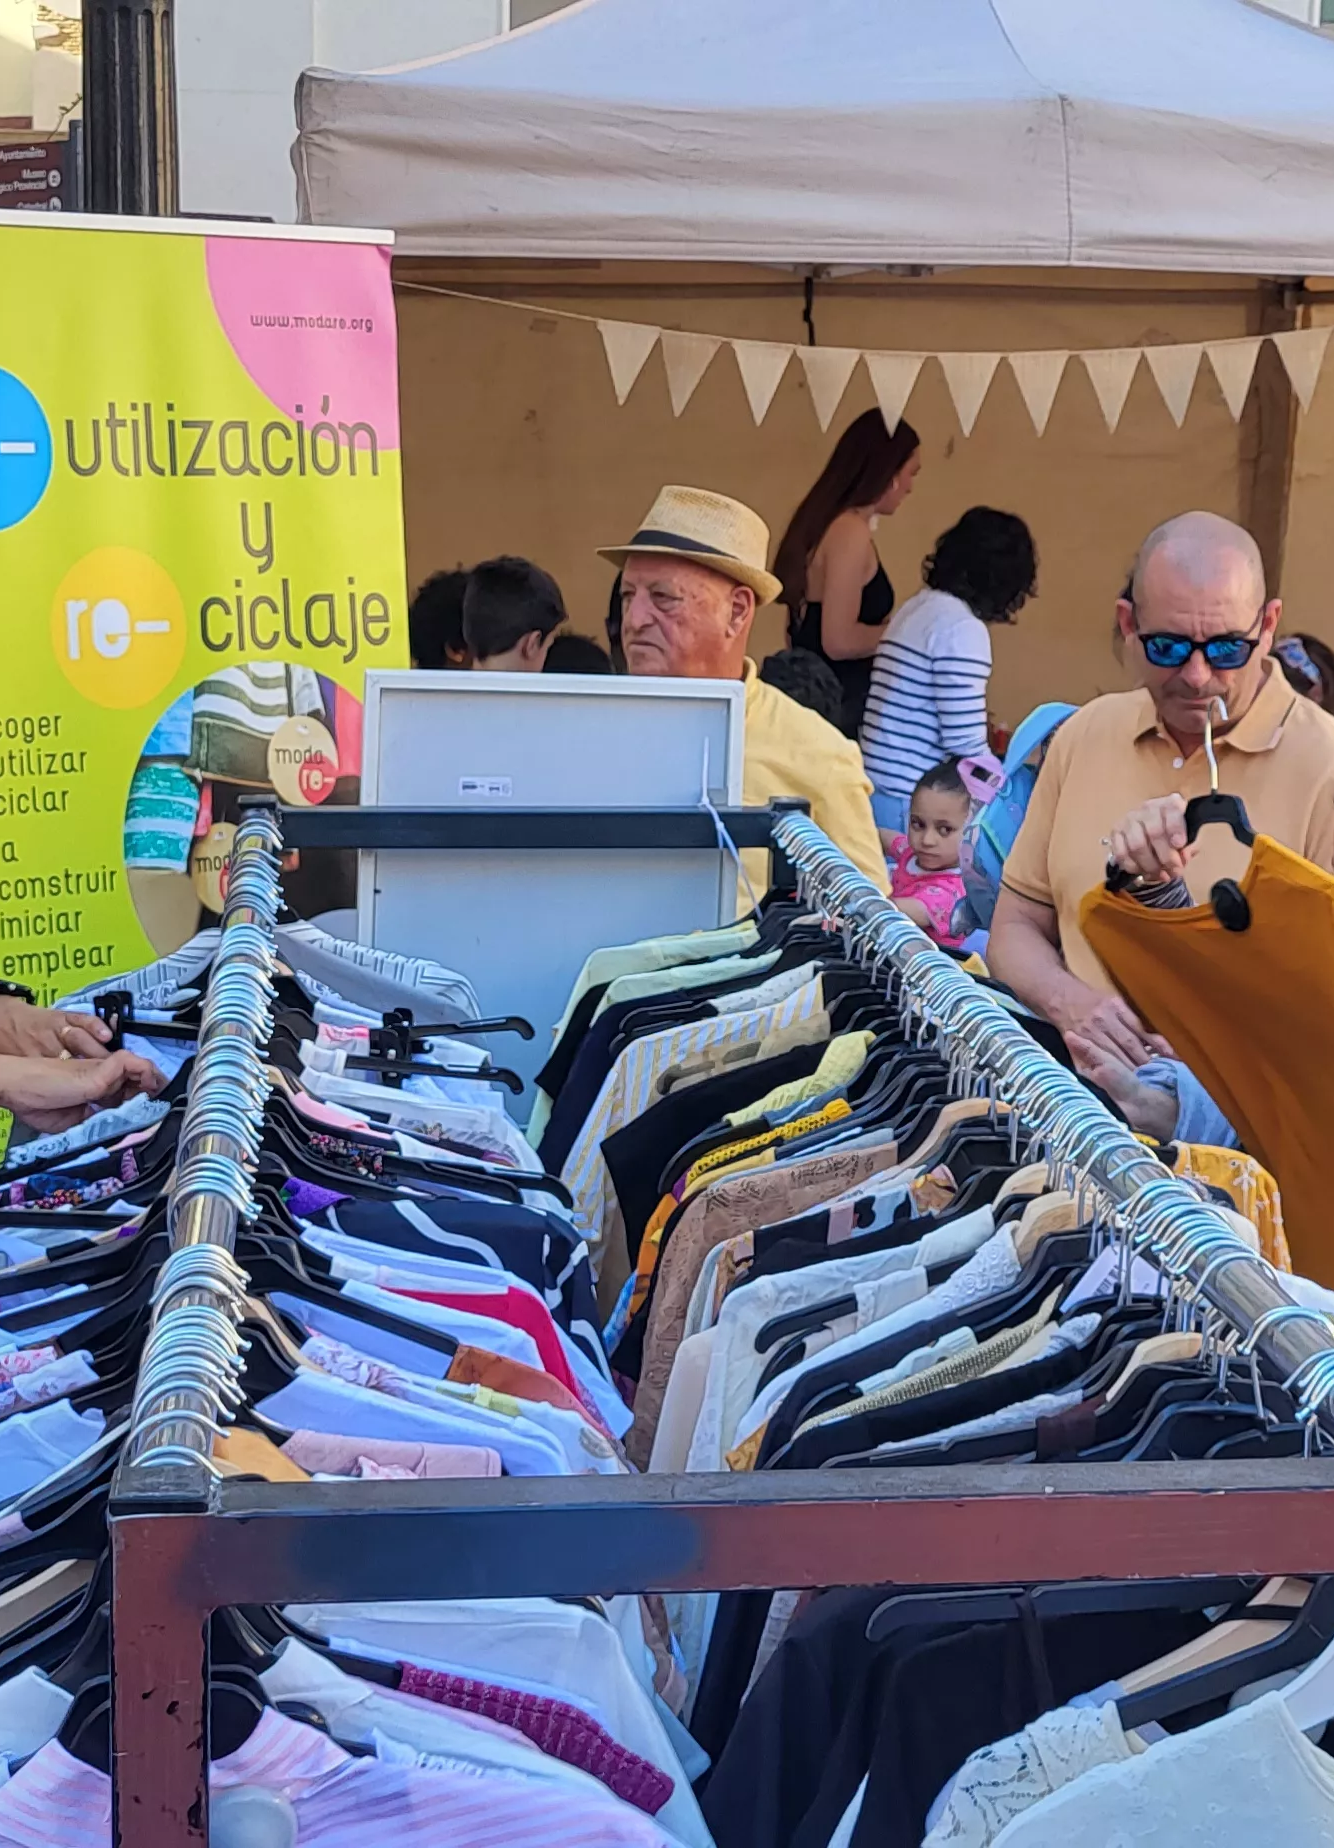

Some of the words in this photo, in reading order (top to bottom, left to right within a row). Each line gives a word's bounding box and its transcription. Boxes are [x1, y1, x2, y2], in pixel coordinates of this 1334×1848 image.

[250, 315, 373, 333] www.modare.org
[65, 395, 380, 478] utilización
[239, 501, 273, 573] y
[66, 598, 170, 660] re-
[199, 576, 391, 663] ciclaje
[275, 745, 324, 764] moda
[195, 849, 231, 872] mod
